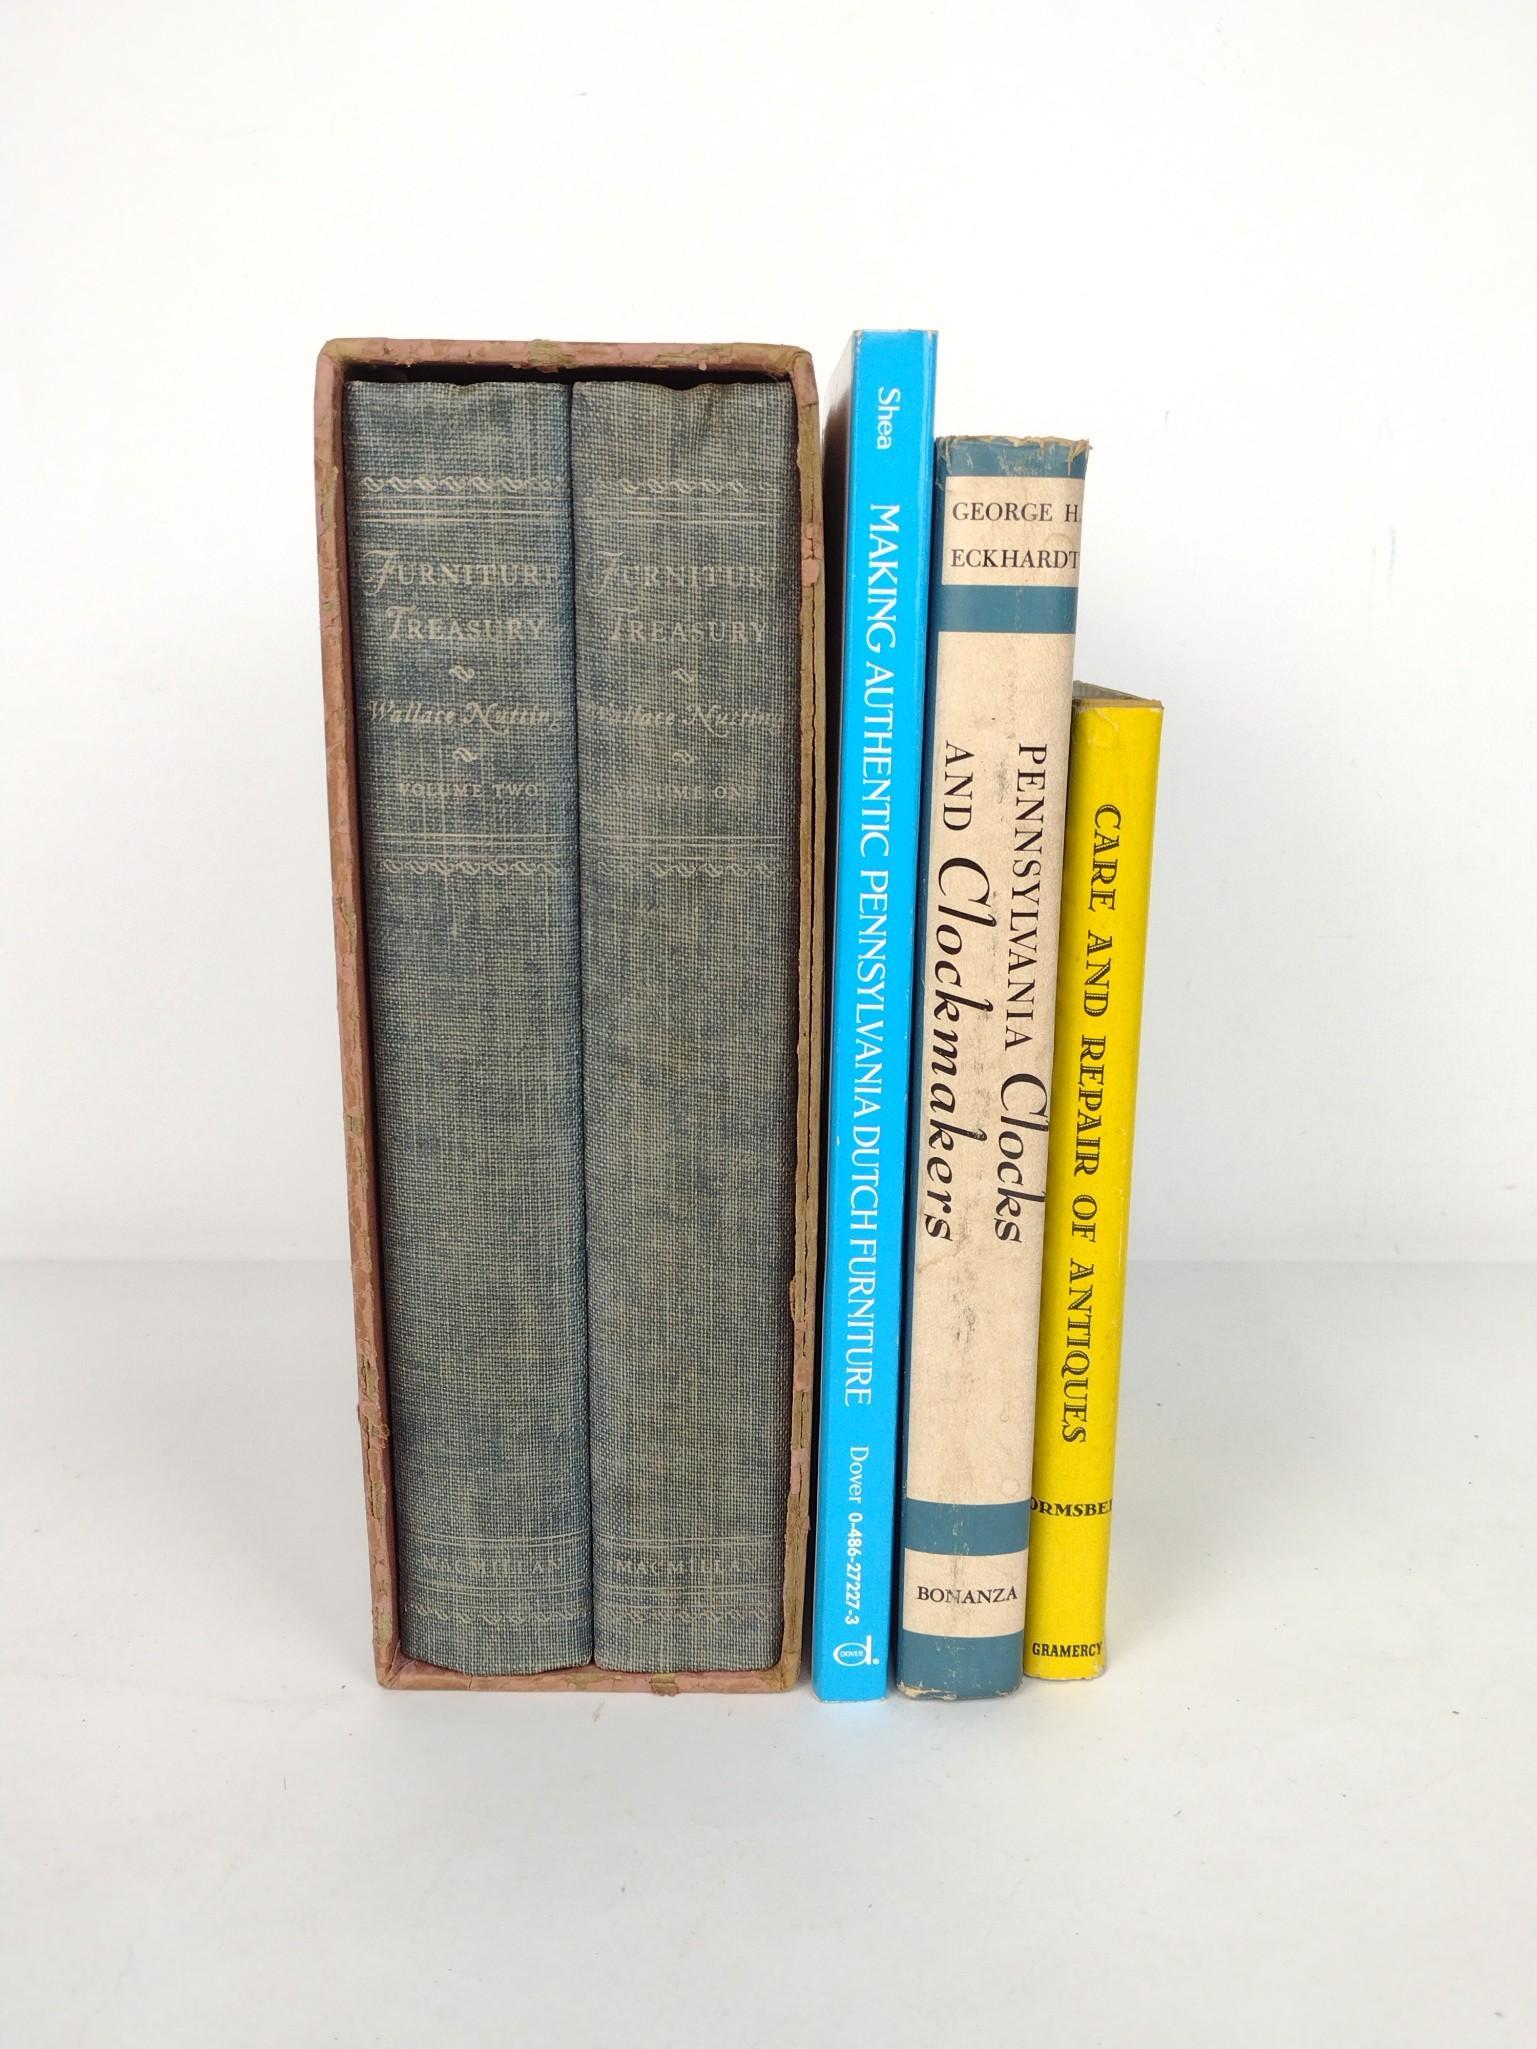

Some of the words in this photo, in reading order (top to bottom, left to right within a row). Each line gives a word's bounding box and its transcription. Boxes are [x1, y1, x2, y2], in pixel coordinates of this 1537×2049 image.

[877, 387, 901, 450] Shea
[952, 502, 1053, 522] GEORGE
[361, 550, 561, 597] FURNITURE
[585, 551, 779, 597] FURNITUR
[865, 504, 901, 654] MAKING
[951, 549, 1080, 569] ECKHARDT
[386, 604, 546, 641] TREASURY
[608, 607, 769, 642] TREASURY
[368, 700, 456, 723] Wallace
[463, 701, 562, 734] Nutting
[399, 783, 482, 798] VOLUME
[493, 783, 539, 797] TWO
[860, 661, 895, 857] AUTHENTIC
[942, 740, 975, 831] AND
[1087, 804, 1122, 912] CARE
[1004, 743, 1048, 1051] PENNSYLVANIA
[853, 870, 889, 1119] PENNSYLVANIA
[1083, 929, 1113, 1017] AND
[923, 857, 998, 1242] Clockmakers
[1073, 1034, 1107, 1177] REPAIR
[849, 1126, 881, 1231] DUTCH
[994, 1073, 1049, 1243] Clocks
[1070, 1194, 1098, 1243] OF
[845, 1239, 877, 1407] FURNITURE
[1061, 1257, 1094, 1443] ANTIQUES
[848, 1446, 869, 1504] Dover
[844, 1512, 864, 1625] 0-486-27227-3
[917, 1585, 1018, 1604] BONANZA
[840, 1650, 864, 1658] DOVER
[1032, 1642, 1103, 1657] GRAMERCY
